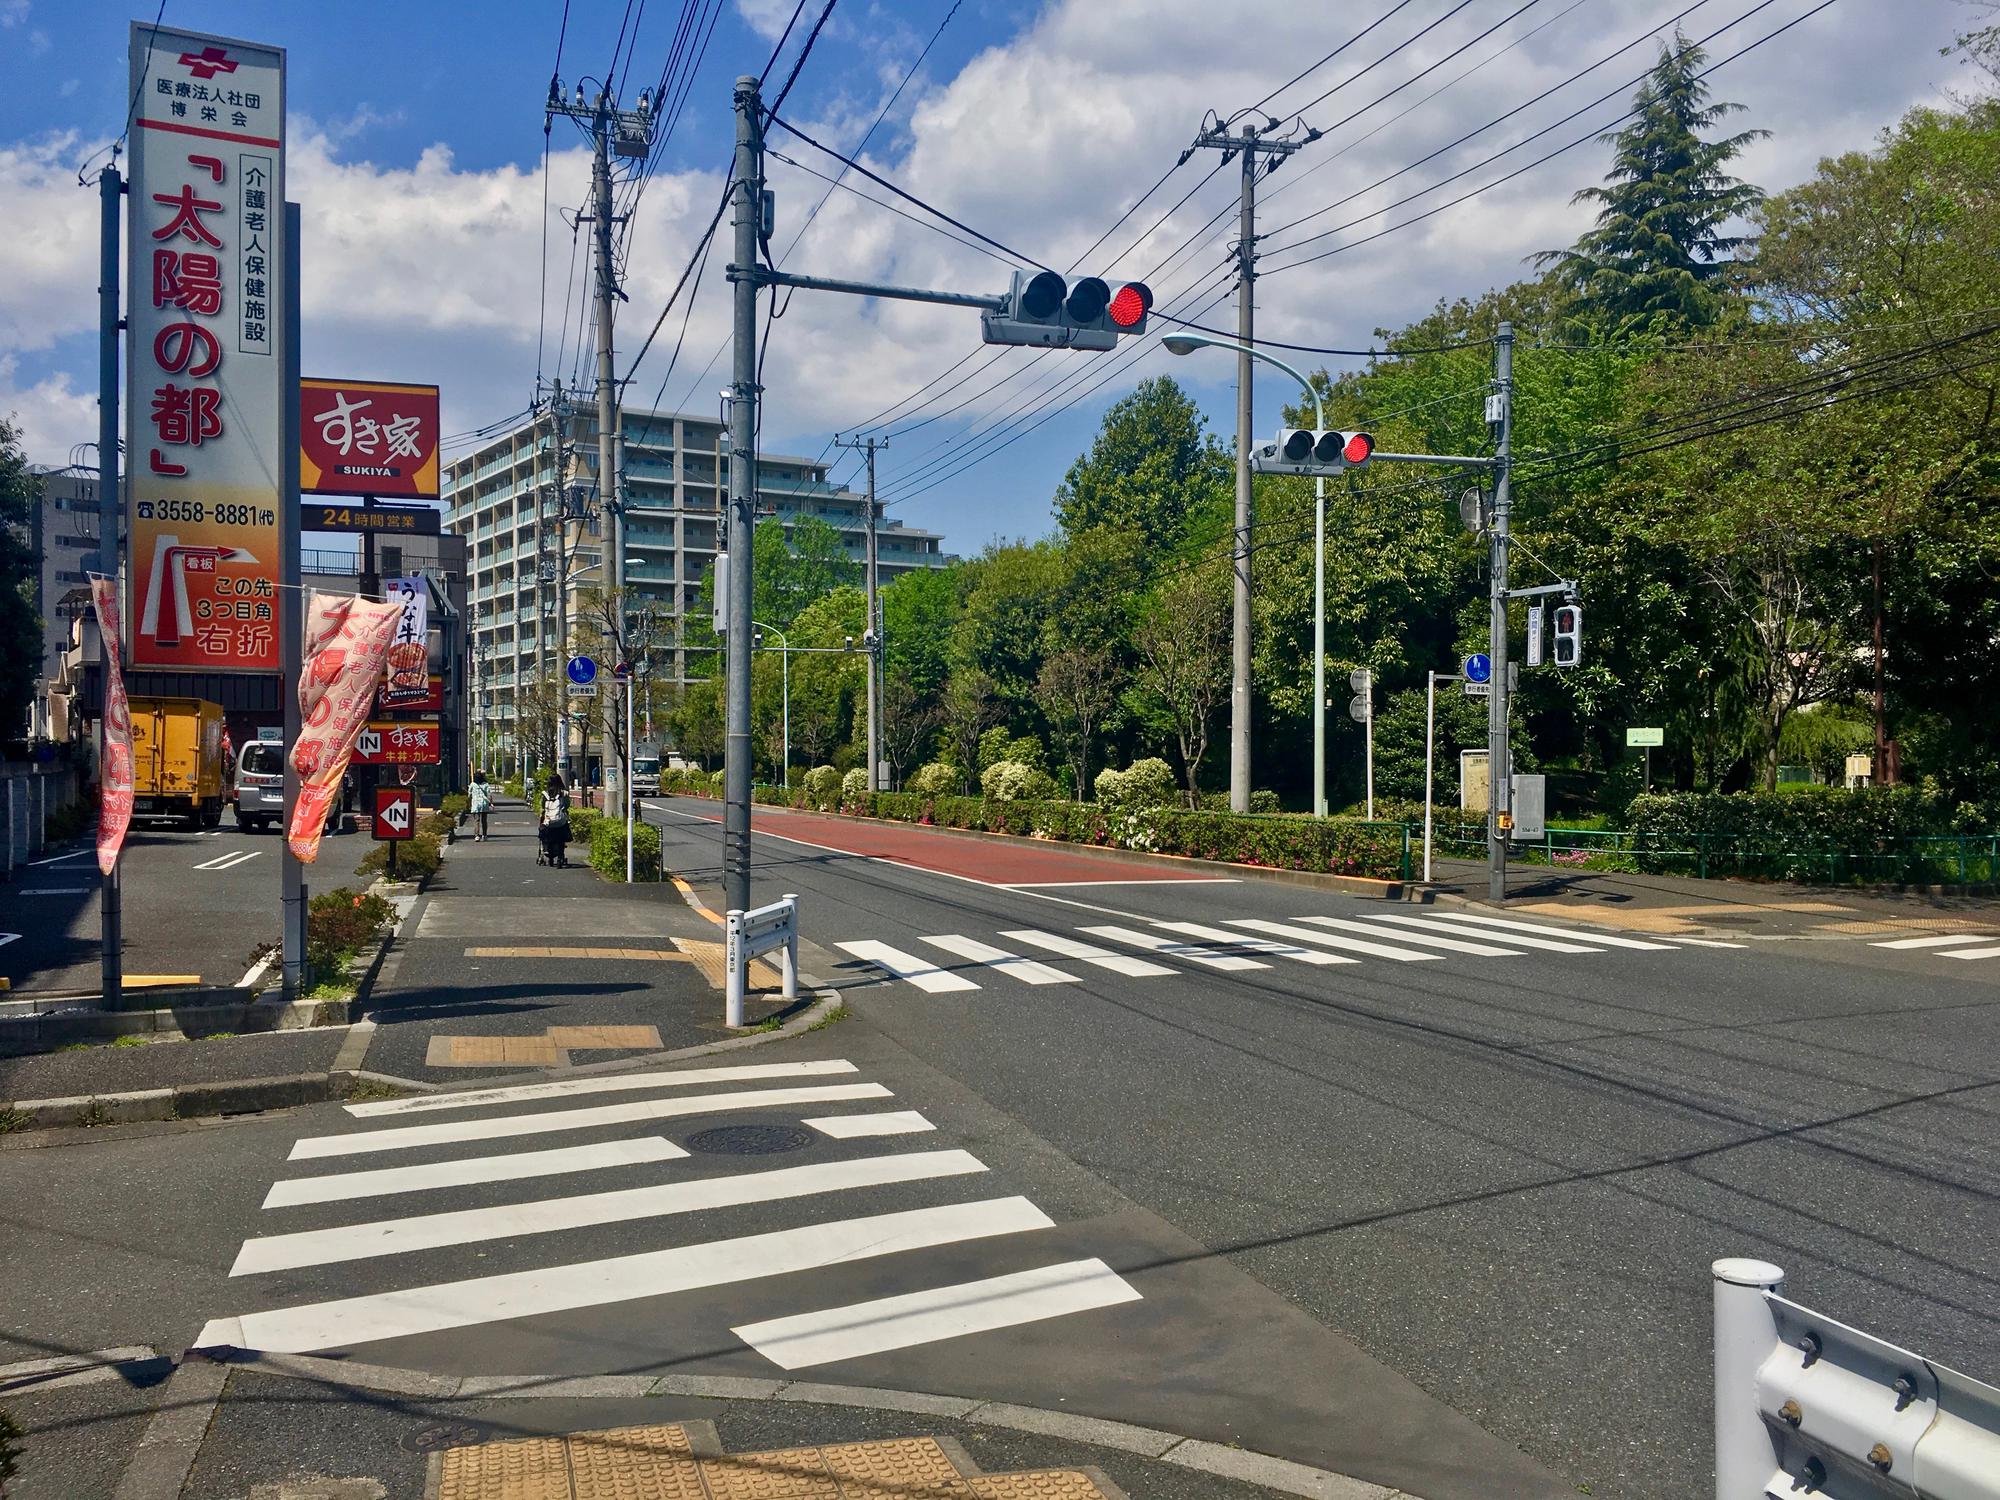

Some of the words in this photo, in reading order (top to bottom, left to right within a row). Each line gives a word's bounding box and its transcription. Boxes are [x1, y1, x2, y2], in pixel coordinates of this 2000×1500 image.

[156, 78, 261, 110] 医療法人社団
[170, 100, 248, 128] 博栄会
[244, 166, 267, 344] 介護老人保健施設
[313, 391, 421, 465] すき家
[343, 465, 392, 477] SUKIYA
[322, 508, 416, 529] 24時間営業
[186, 557, 213, 570] 看板
[215, 577, 273, 598] この先
[197, 599, 272, 621] 3つ目角
[196, 624, 273, 657] 右折
[360, 736, 378, 750] IN
[388, 724, 429, 750] すき家
[388, 808, 407, 822] IN
